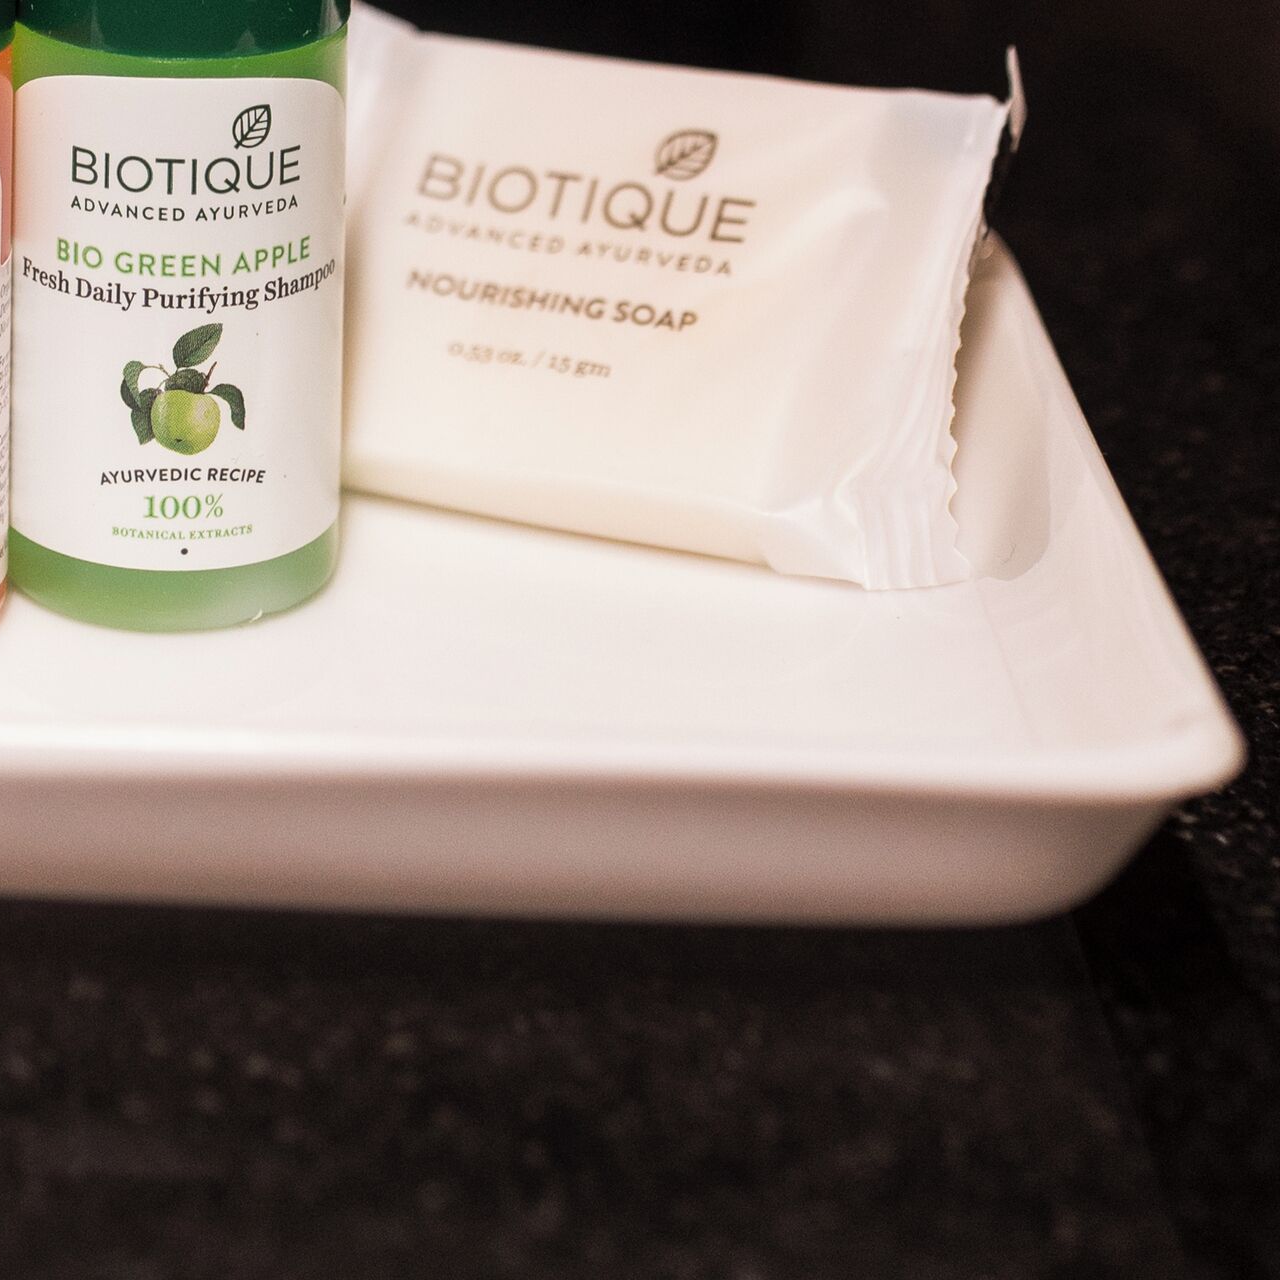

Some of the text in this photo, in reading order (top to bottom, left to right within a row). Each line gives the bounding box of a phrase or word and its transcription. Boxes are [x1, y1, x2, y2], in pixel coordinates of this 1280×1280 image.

[71, 144, 302, 196] BIOTIQUE
[70, 194, 299, 222] ADVANCED AYURVEDA
[416, 152, 758, 245] BIOTIQUE
[56, 235, 312, 277] BIO GREEN APPLE
[404, 212, 734, 277] ADVANCED AYURVEDA
[22, 255, 336, 313] Fresh Daily Purifying Shampoo
[405, 268, 700, 332] NOURISHING SOAP
[447, 341, 494, 365] 0.53
[547, 354, 572, 374] 15
[573, 360, 613, 380] gm
[99, 466, 267, 487] AYURVEDIC RECIPE
[142, 492, 224, 520] 100%
[111, 522, 254, 541] BOTANICAL EXTRACTS
